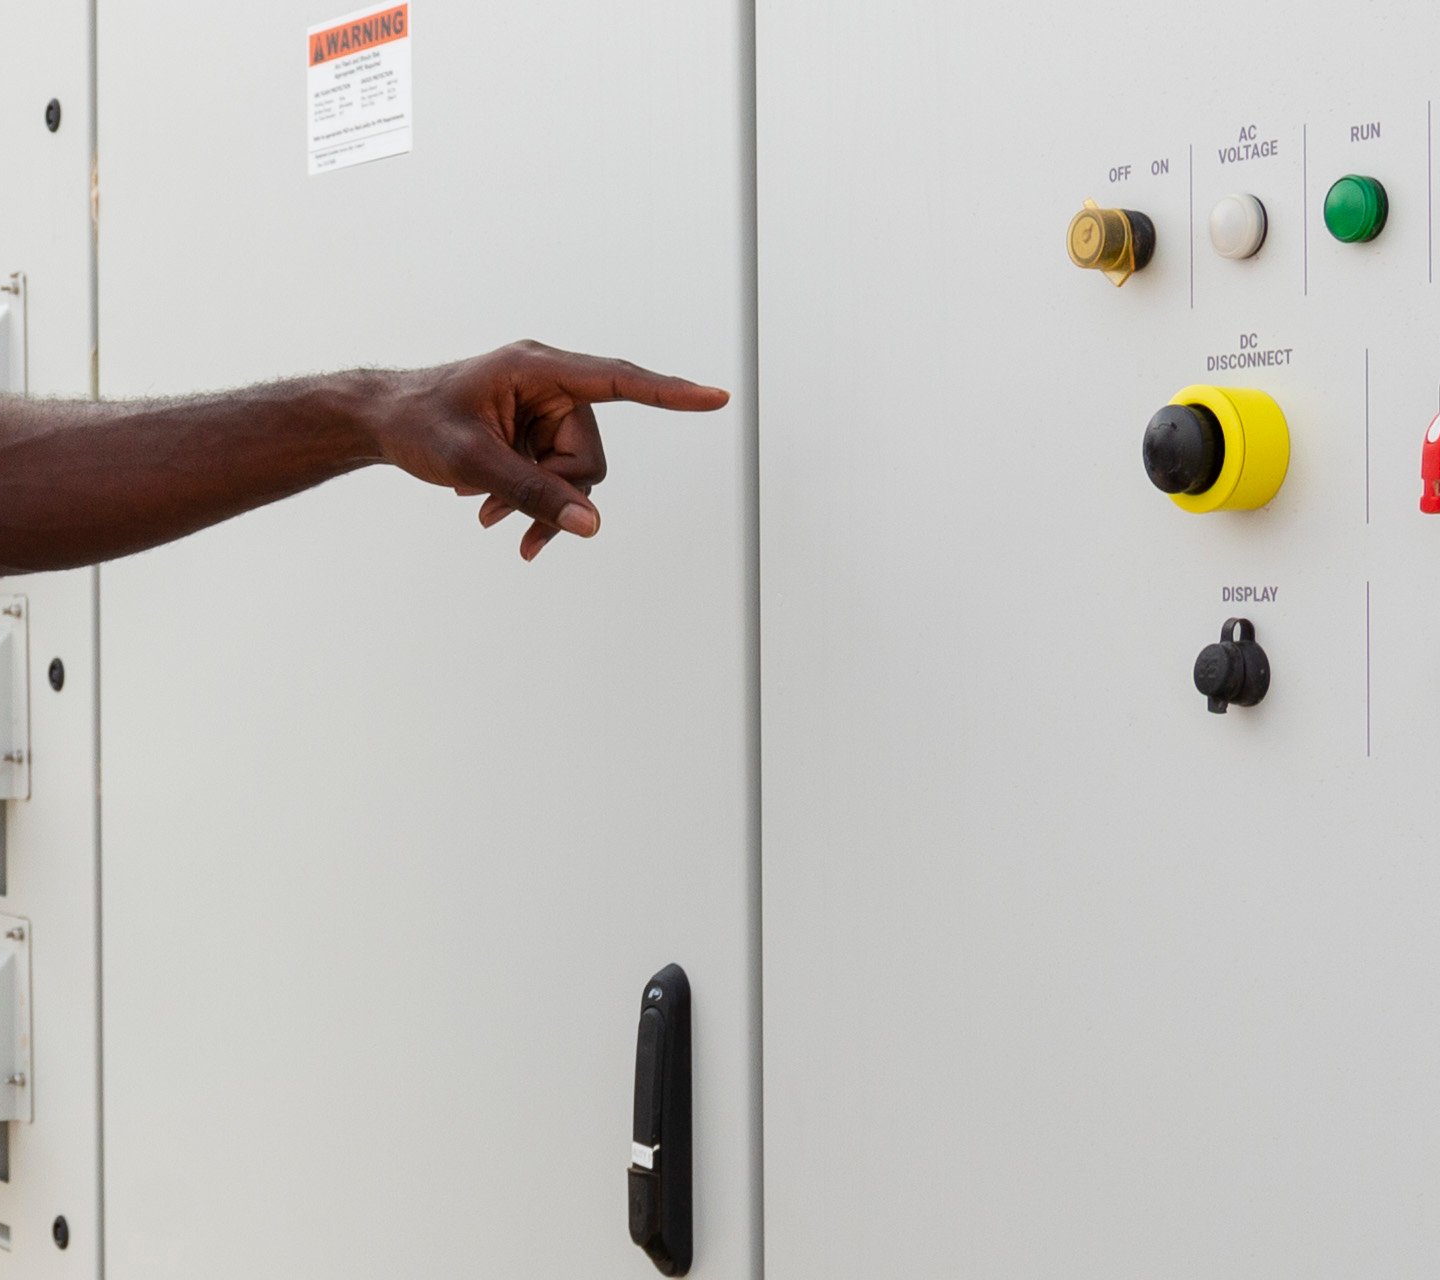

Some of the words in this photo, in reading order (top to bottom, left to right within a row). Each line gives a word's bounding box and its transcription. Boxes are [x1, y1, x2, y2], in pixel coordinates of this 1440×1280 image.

[326, 11, 404, 57] WARNING
[1238, 124, 1257, 143] AC
[1350, 122, 1382, 142] RUN
[1218, 140, 1279, 164] VOLTAGE
[1108, 165, 1132, 183] OFF
[1151, 158, 1169, 176] ON
[1239, 333, 1259, 350] DC
[1206, 348, 1293, 372] DISCONNECT
[1222, 586, 1279, 603] DISPLAY
